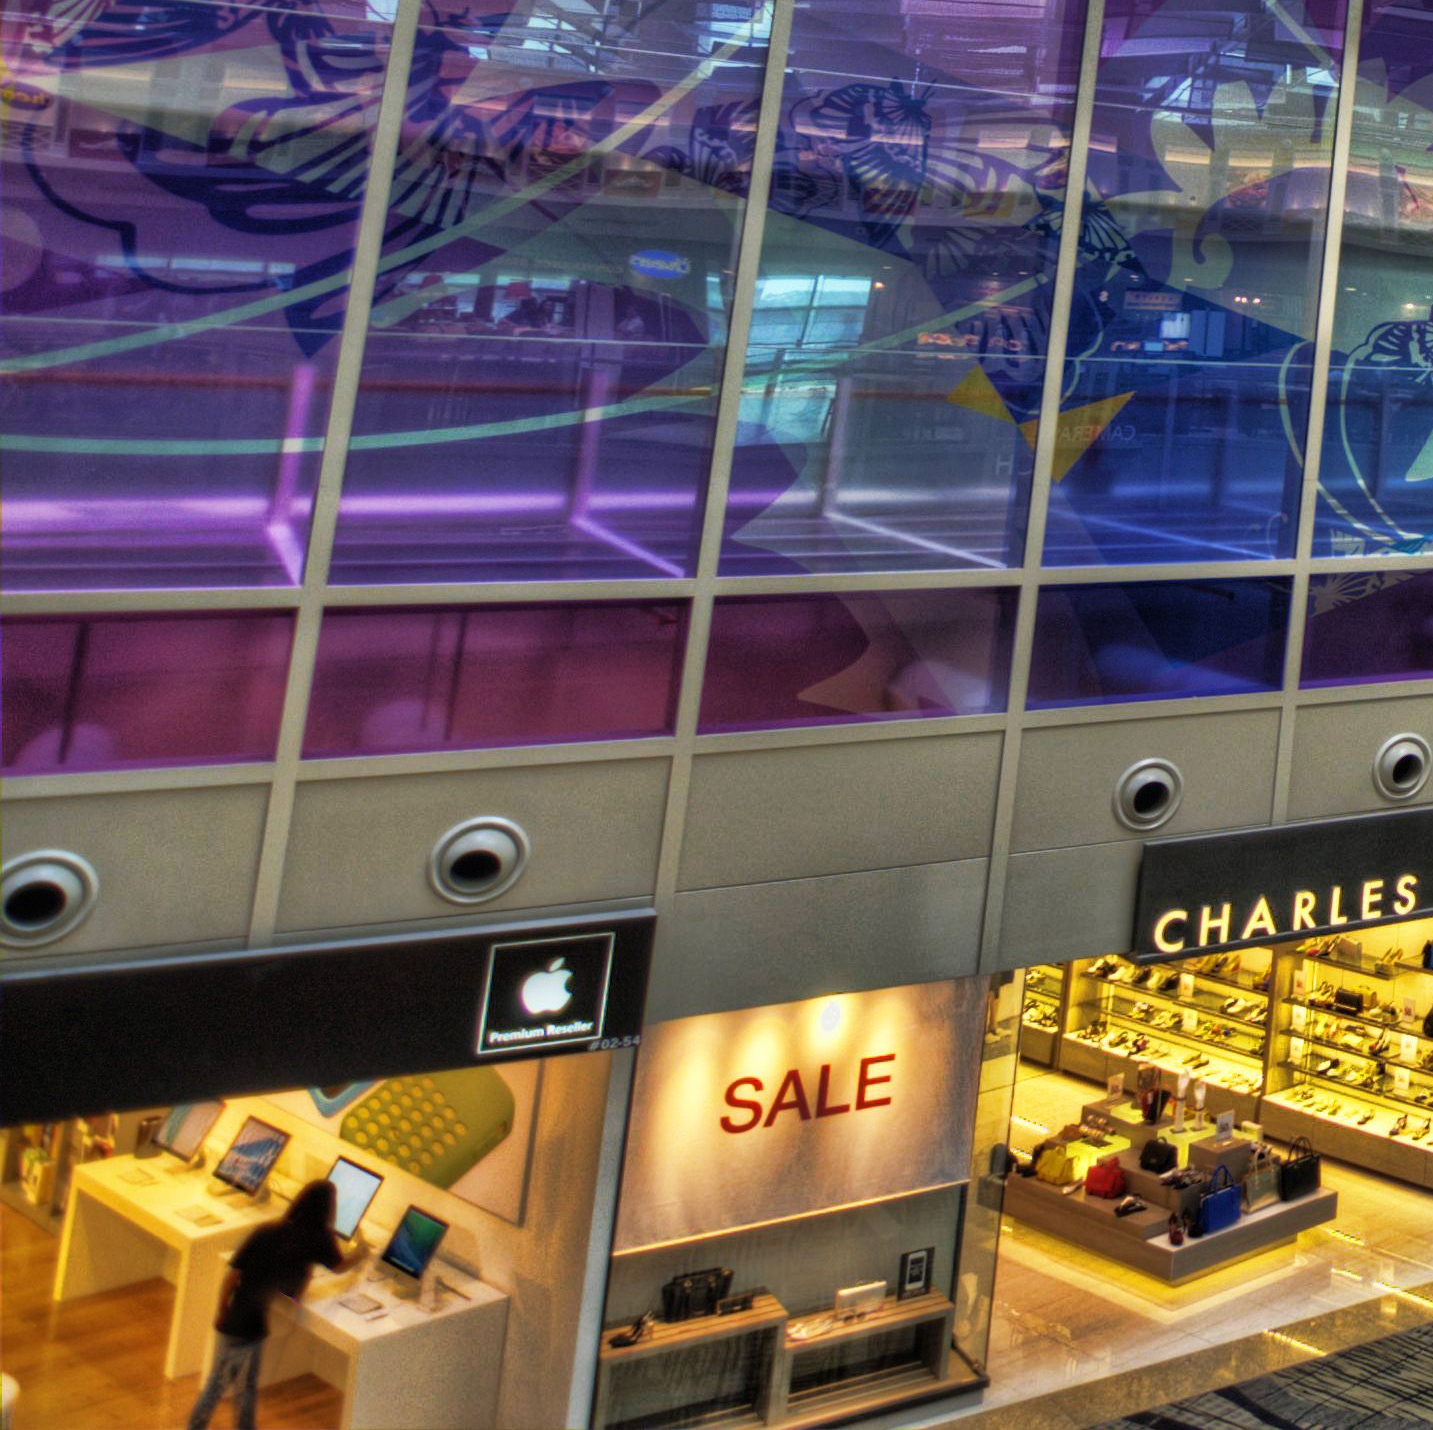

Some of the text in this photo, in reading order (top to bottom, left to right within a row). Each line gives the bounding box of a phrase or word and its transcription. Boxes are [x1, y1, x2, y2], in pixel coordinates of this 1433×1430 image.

[1154, 873, 1418, 953] CHARLES
[488, 1019, 594, 1045] Premium Reseller
[588, 1034, 641, 1052] #02-54
[720, 1053, 897, 1134] SALE
